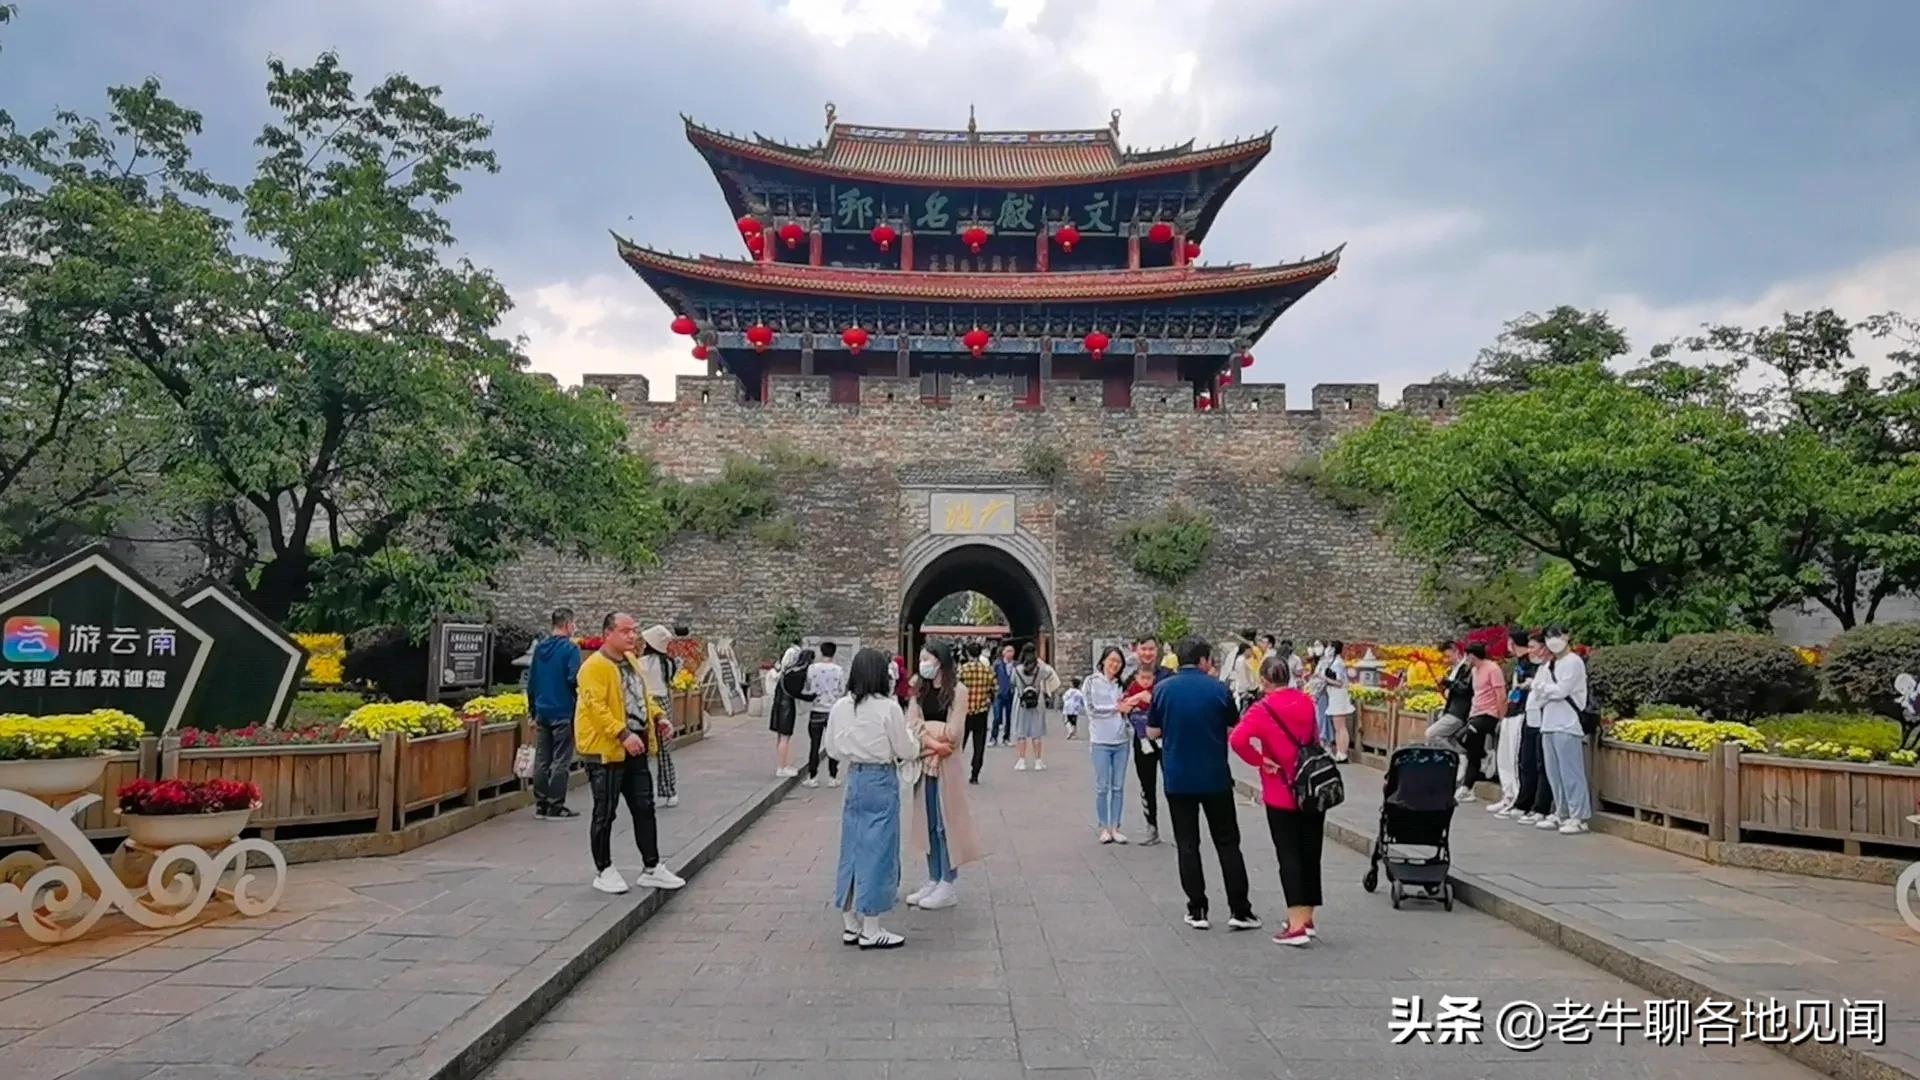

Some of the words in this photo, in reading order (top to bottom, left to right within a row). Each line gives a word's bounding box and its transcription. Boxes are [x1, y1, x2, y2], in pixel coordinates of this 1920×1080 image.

[68, 624, 177, 657] 游云南
[0, 668, 167, 689] 大理古城欢迎您
